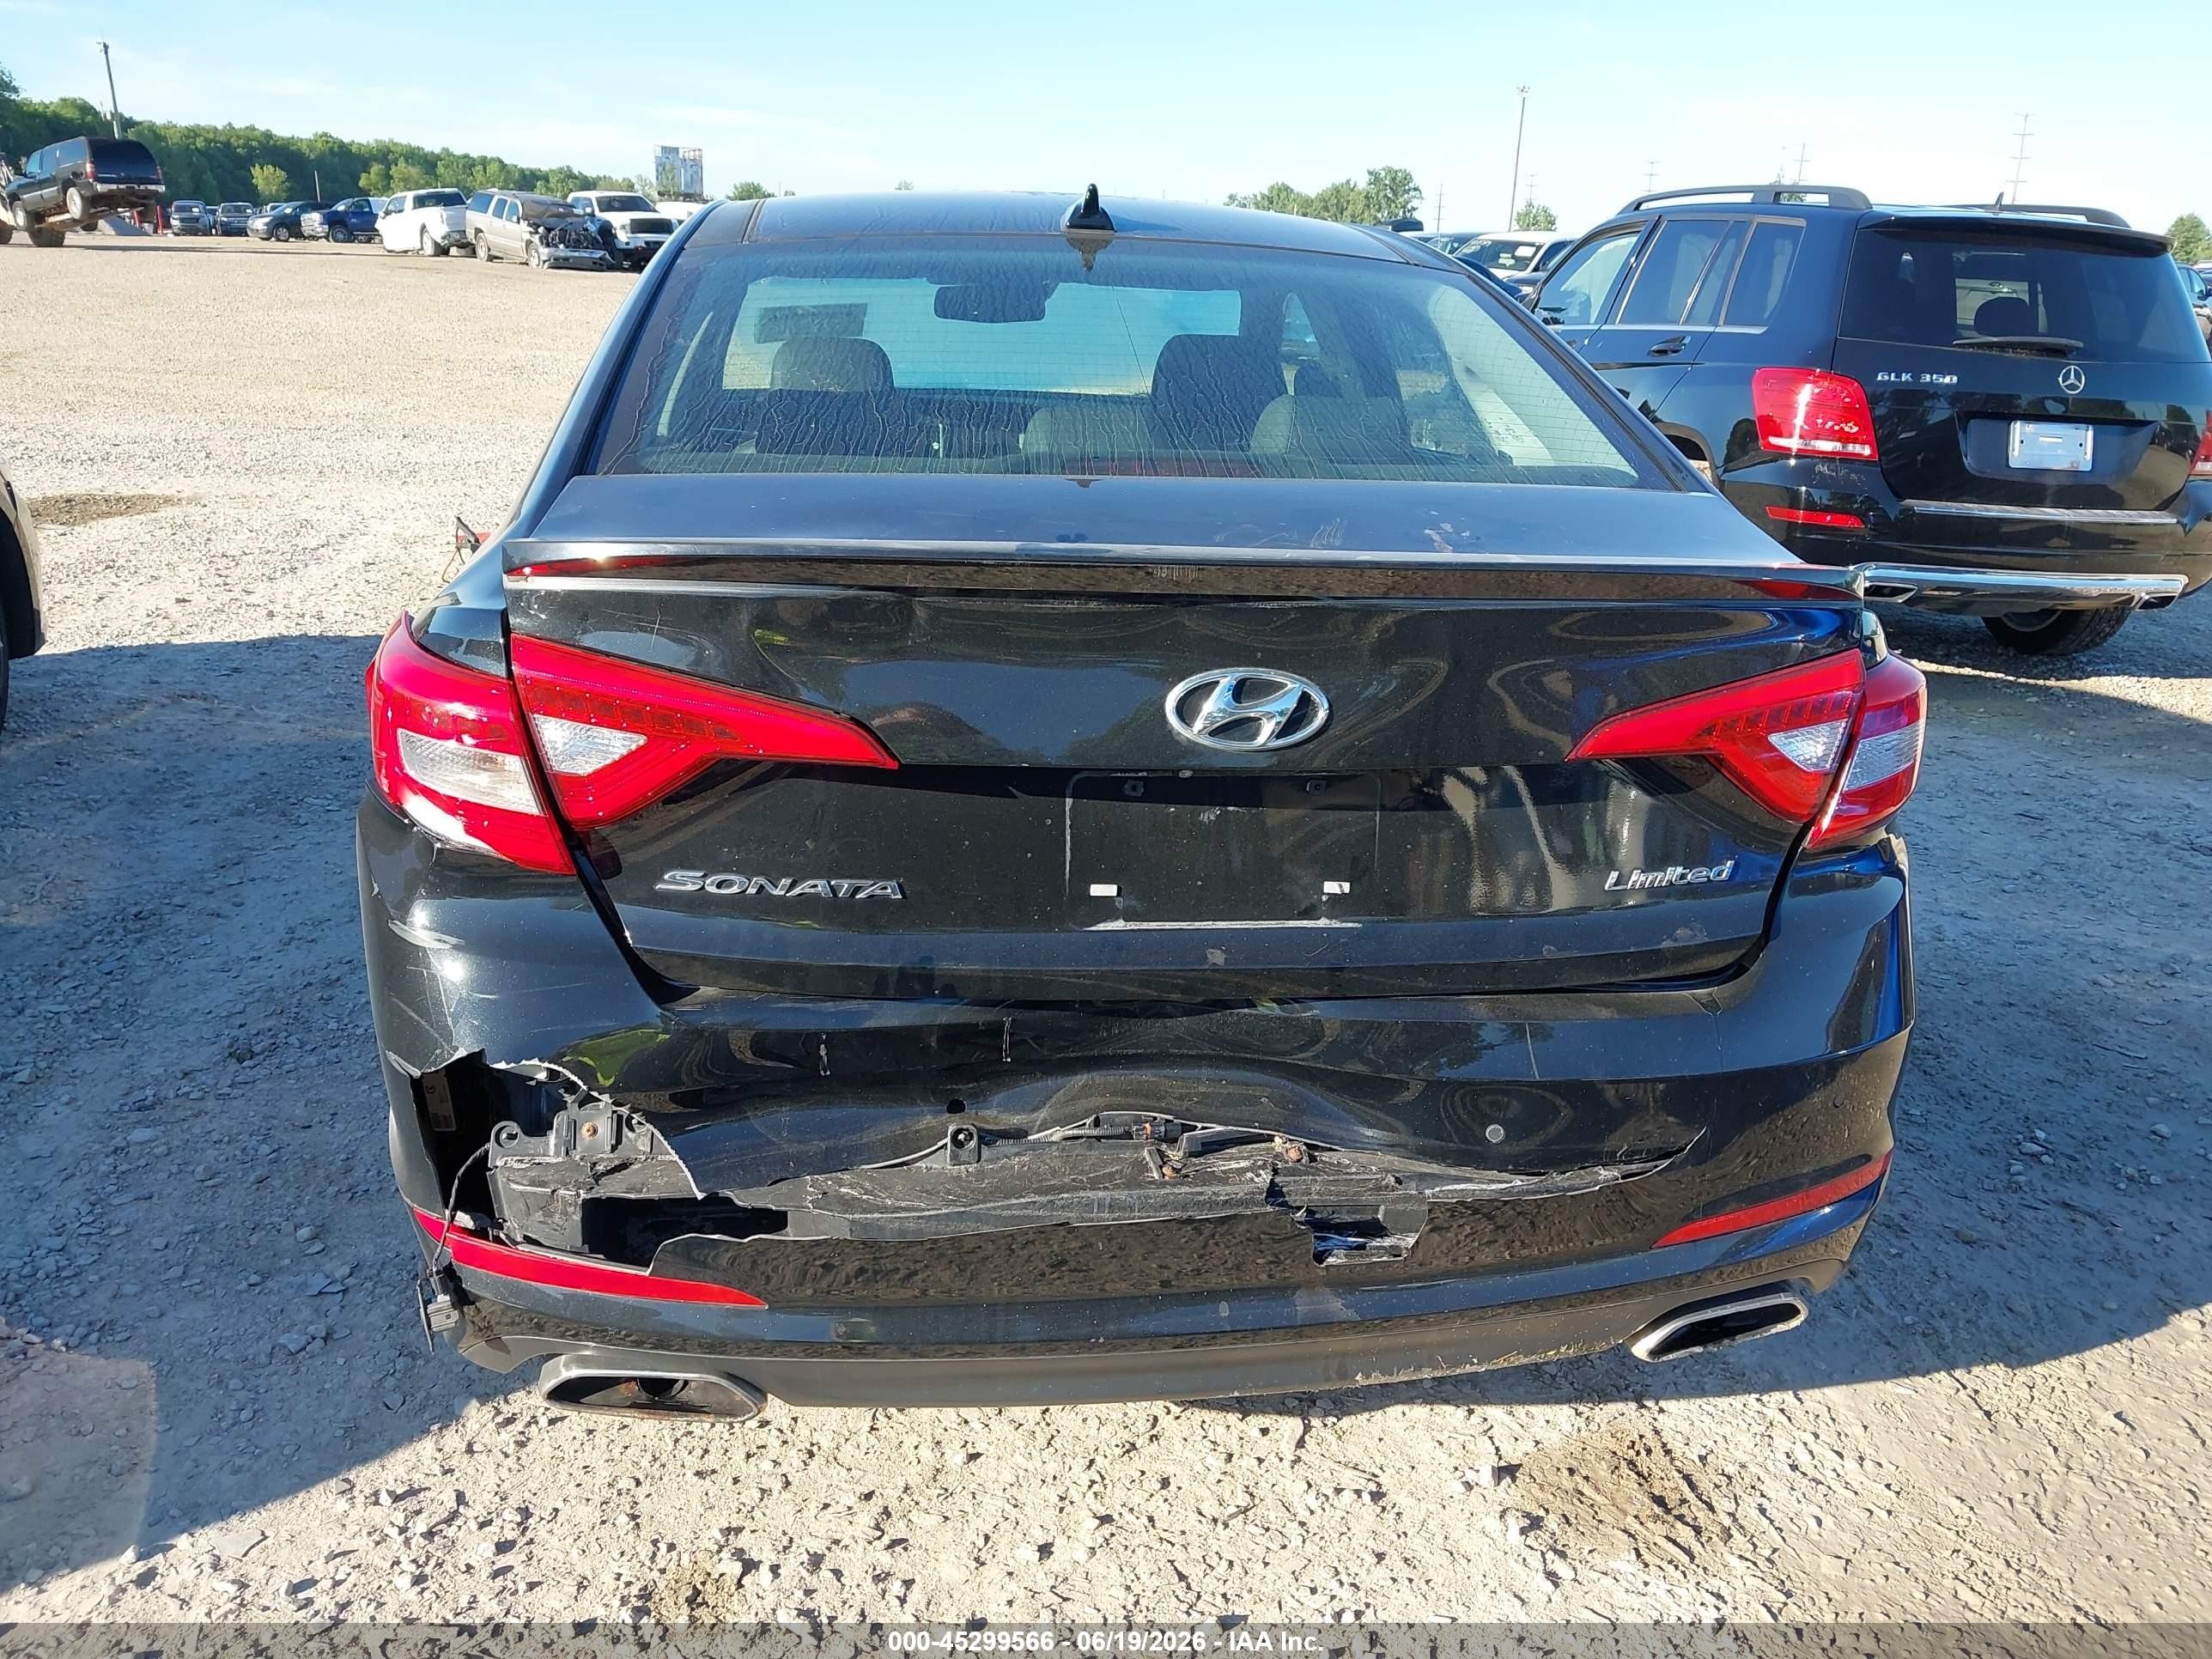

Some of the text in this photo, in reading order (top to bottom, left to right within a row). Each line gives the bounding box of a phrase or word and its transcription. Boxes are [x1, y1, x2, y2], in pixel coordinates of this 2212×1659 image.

[1876, 372, 1958, 384] GLK 350
[654, 871, 903, 899] SONATA
[1604, 860, 1735, 891] Limited
